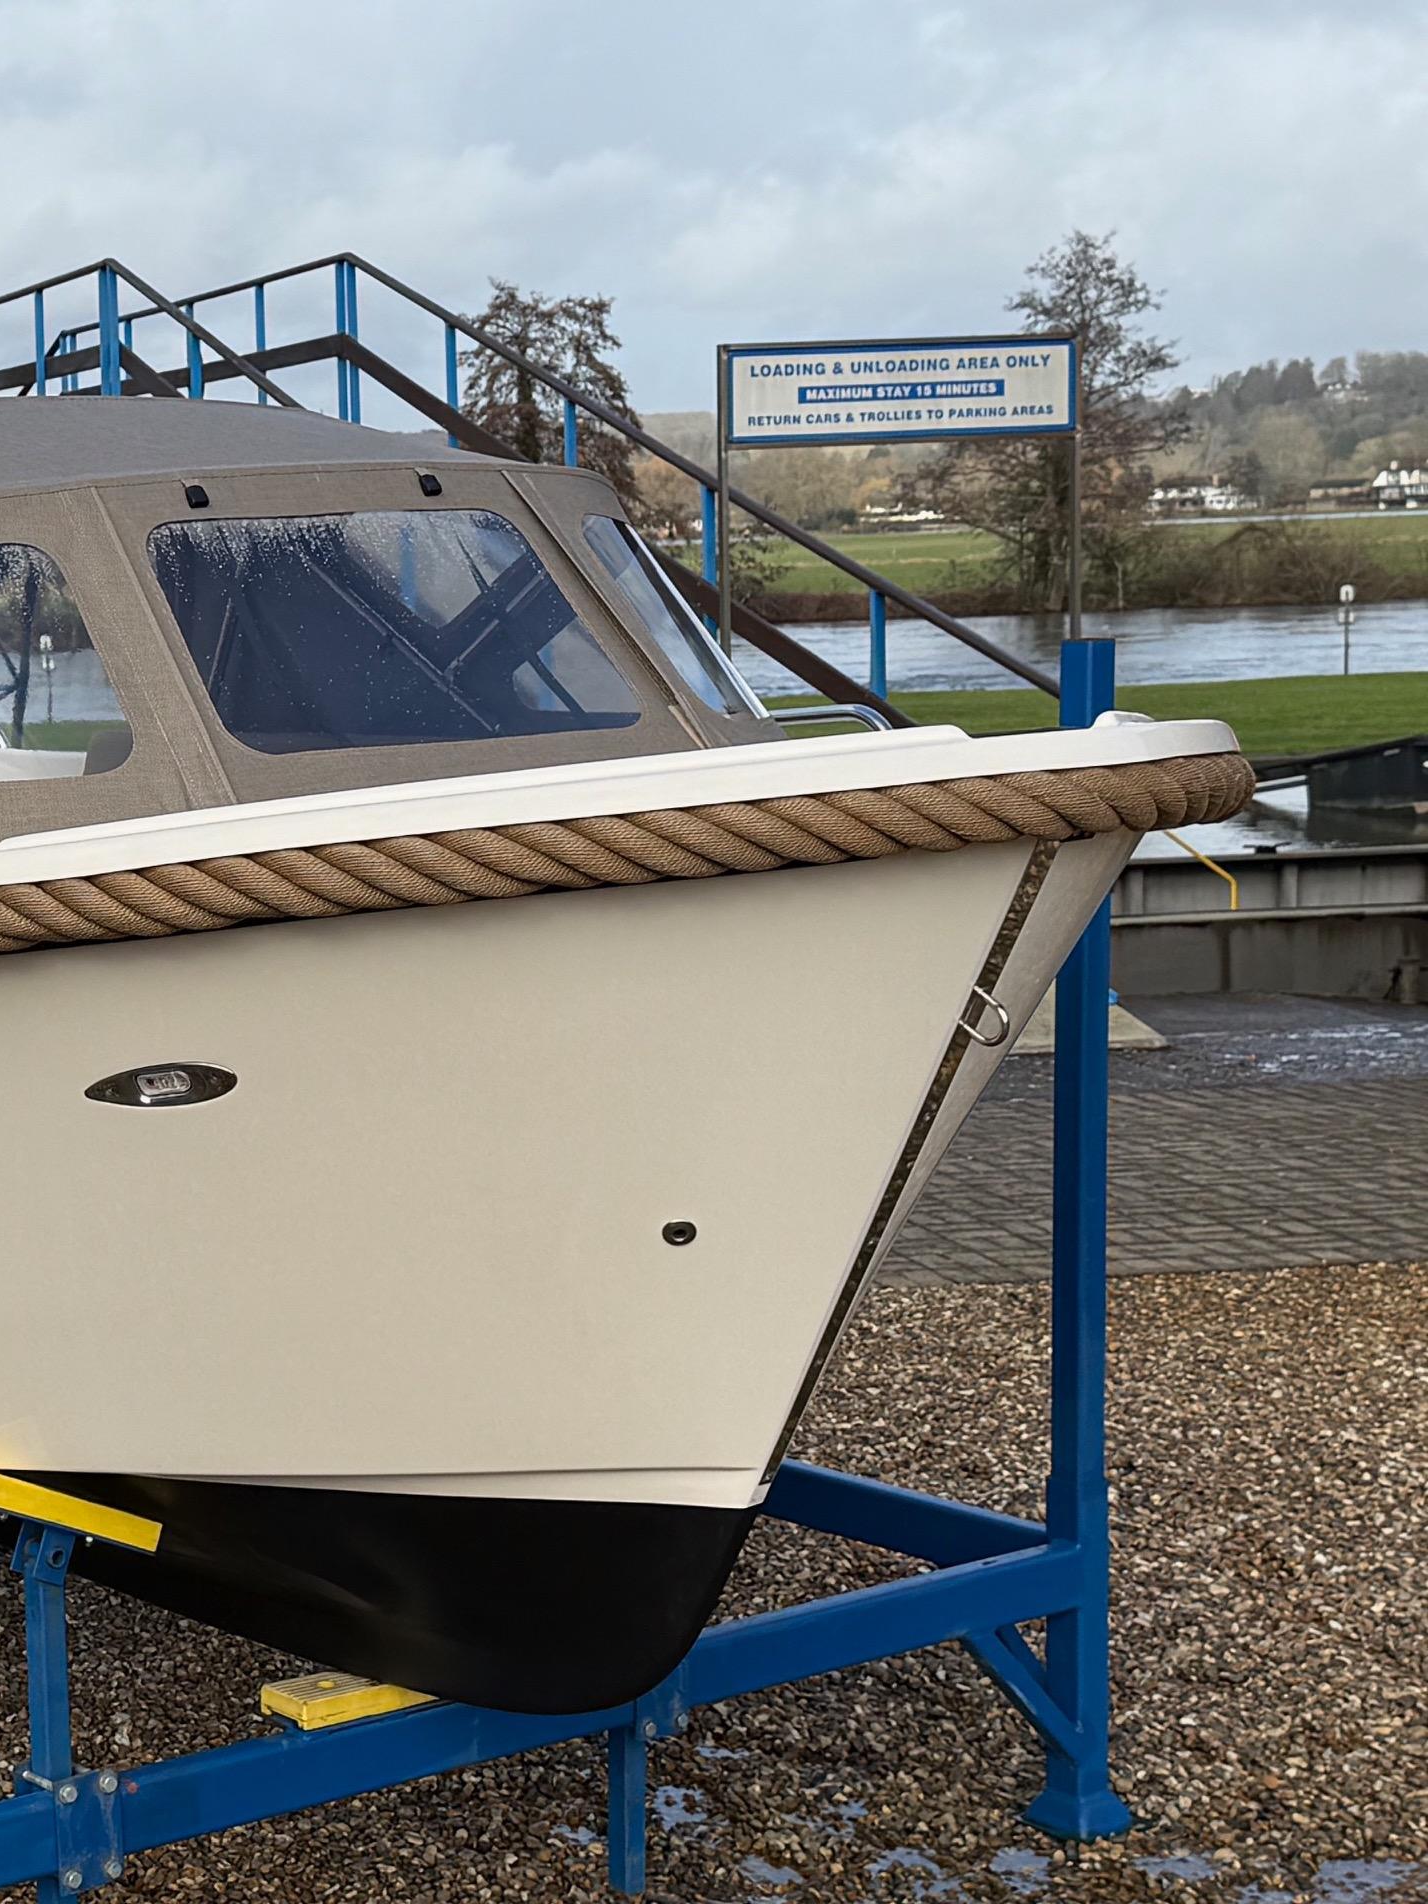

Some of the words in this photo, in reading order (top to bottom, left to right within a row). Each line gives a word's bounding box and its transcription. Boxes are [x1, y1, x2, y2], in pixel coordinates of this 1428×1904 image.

[750, 362, 826, 378] LOADING
[832, 361, 843, 375] &
[850, 358, 950, 374] UNLOADING
[956, 356, 1000, 370] AREA
[1005, 354, 1051, 368] ONLY
[806, 387, 873, 401] MAXIMUM
[876, 385, 912, 398] STAY
[916, 385, 932, 397] 15
[935, 382, 997, 396] MINUTES
[747, 414, 801, 427] RETURN
[806, 412, 841, 425] CARS
[845, 412, 854, 423] &
[859, 409, 922, 423] TROLLIES
[926, 408, 944, 420] TO
[948, 406, 1007, 419] PARKING
[1011, 404, 1054, 416] AREAS
